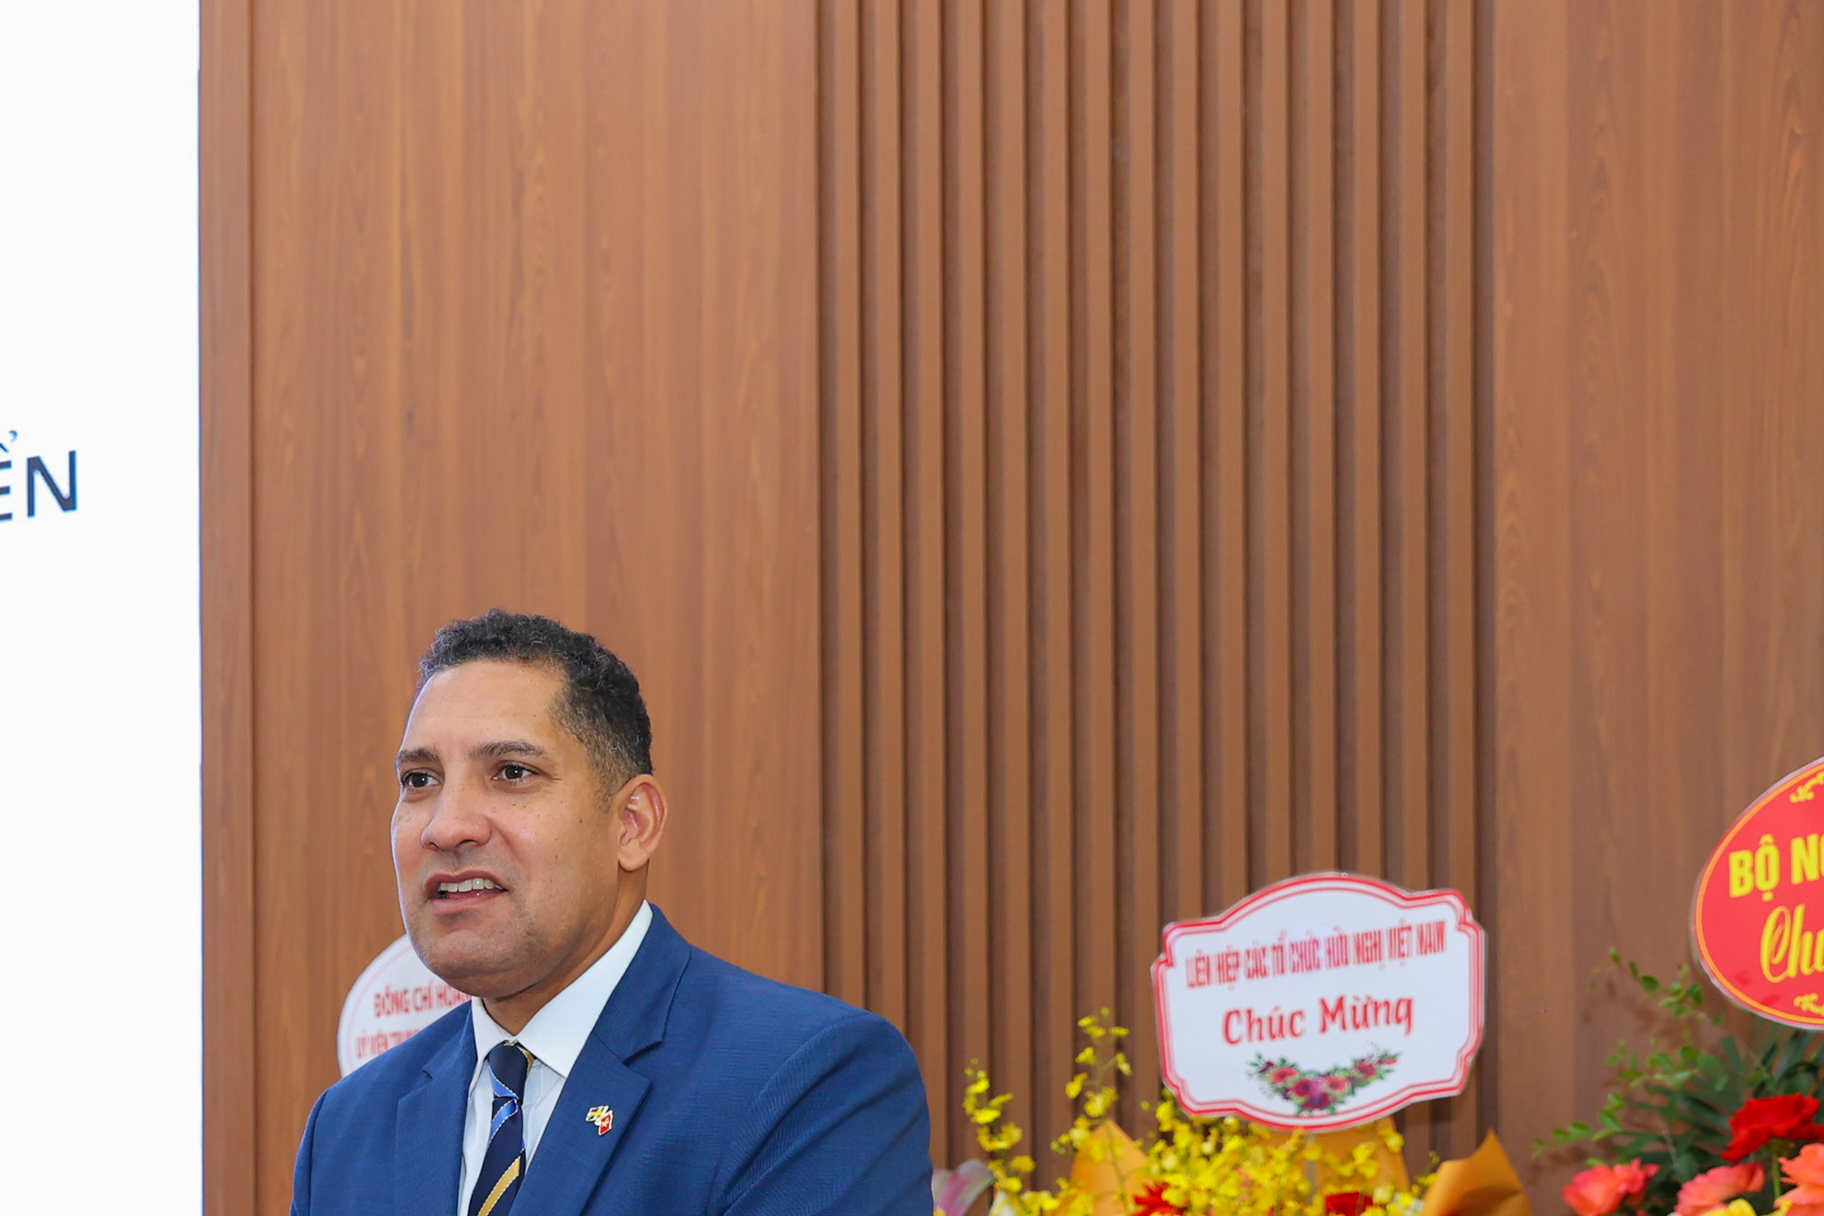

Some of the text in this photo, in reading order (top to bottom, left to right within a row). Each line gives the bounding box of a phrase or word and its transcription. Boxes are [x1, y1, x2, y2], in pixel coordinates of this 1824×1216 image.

[1729, 834, 1781, 901] BỘ
[1416, 920, 1446, 955] NAM
[1222, 995, 1415, 1046] Chúc Mừng
